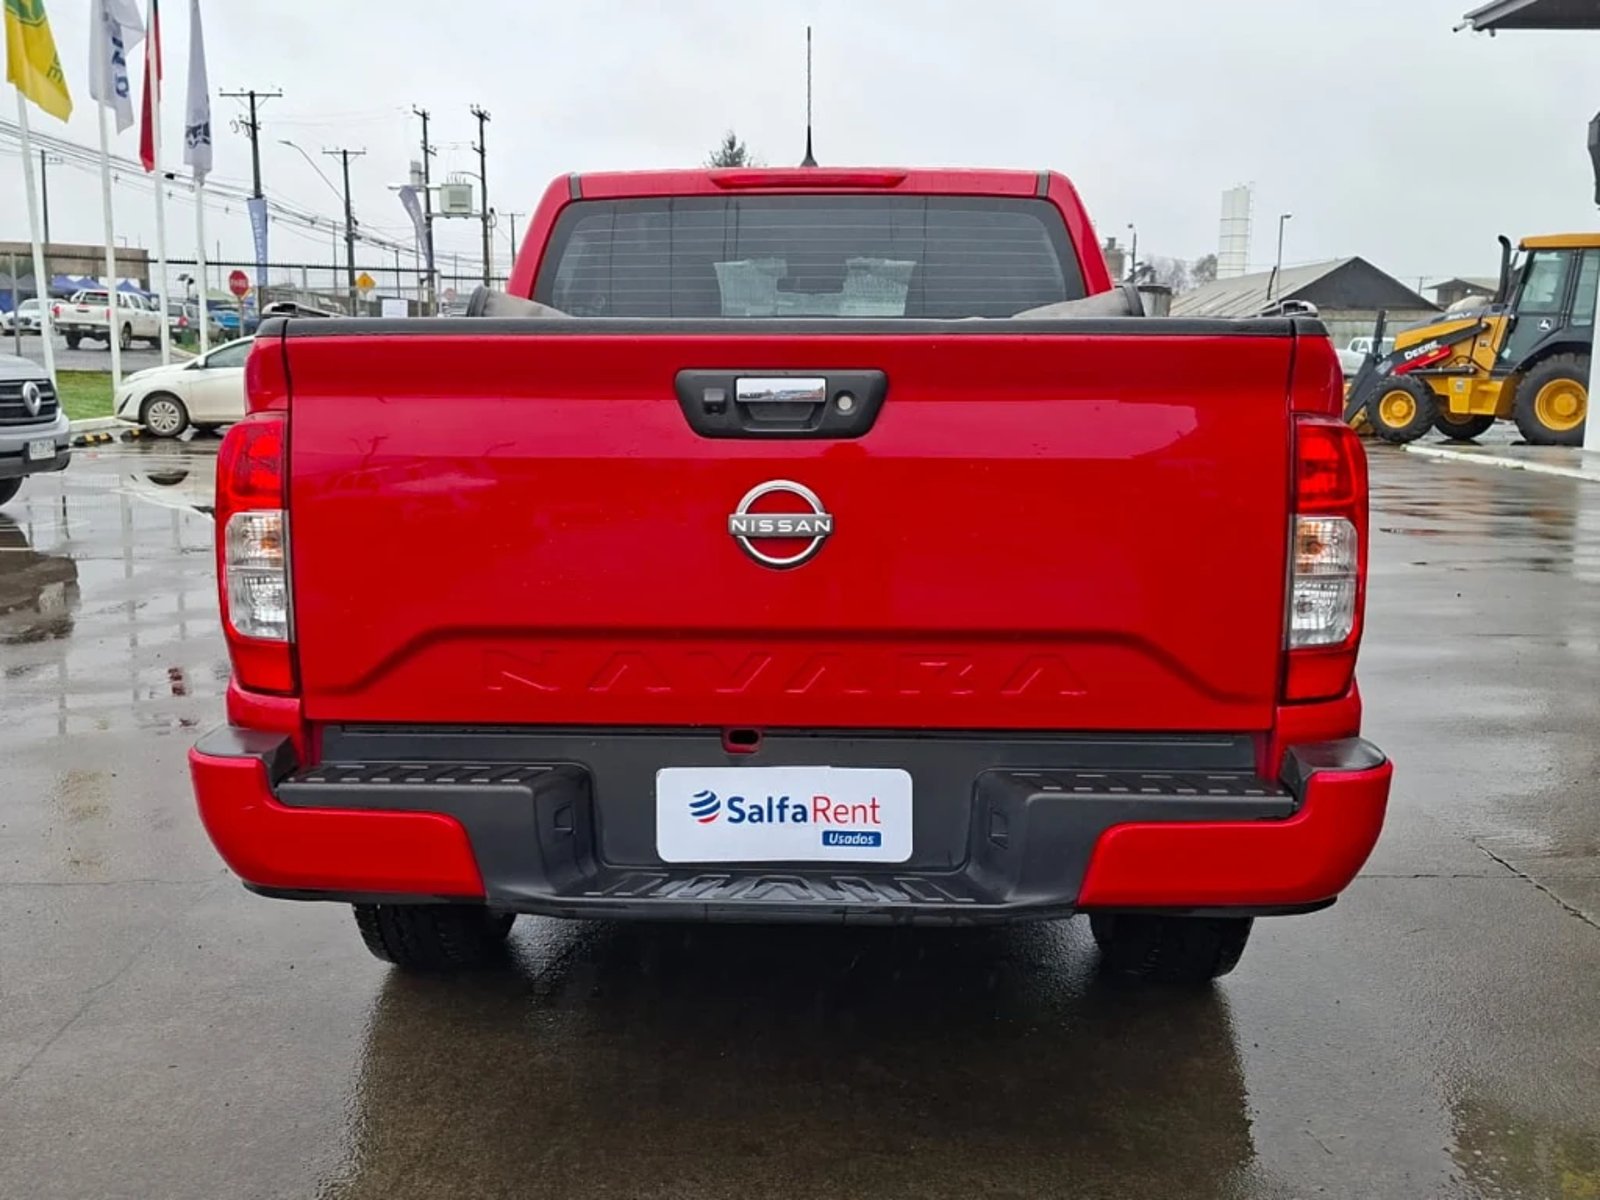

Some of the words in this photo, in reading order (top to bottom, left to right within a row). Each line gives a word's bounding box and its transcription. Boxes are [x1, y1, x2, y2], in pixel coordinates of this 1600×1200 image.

[1404, 340, 1440, 360] DEERE
[731, 519, 830, 532] NISSAN
[483, 650, 1088, 695] NAVARA
[727, 796, 881, 824] SalfaRent
[829, 833, 874, 845] Usados
